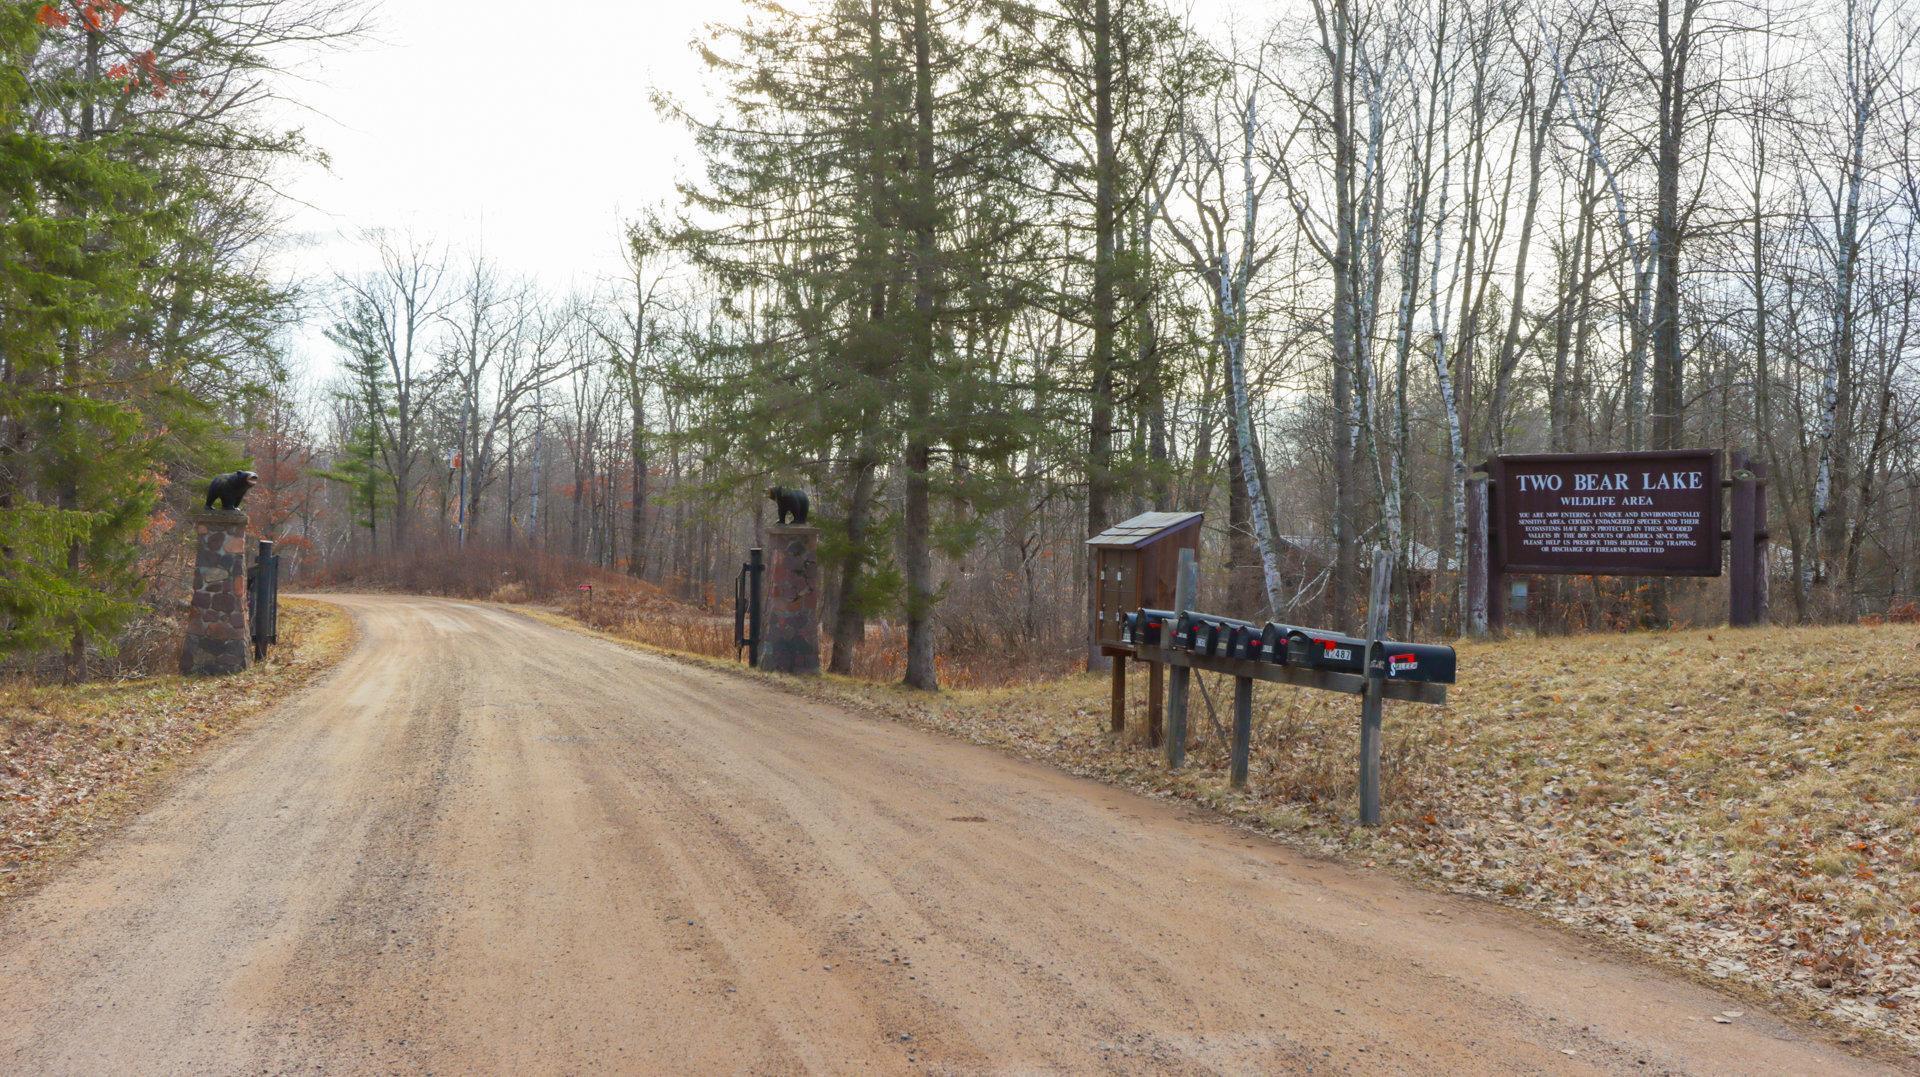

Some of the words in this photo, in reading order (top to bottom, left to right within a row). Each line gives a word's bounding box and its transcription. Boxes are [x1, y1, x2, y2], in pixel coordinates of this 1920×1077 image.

[1516, 474, 1562, 492] TWO
[1575, 473, 1629, 491] BEAR
[1642, 472, 1703, 490] LAKE
[1561, 497, 1616, 506] WILDLIFE
[1622, 496, 1654, 506] AREA
